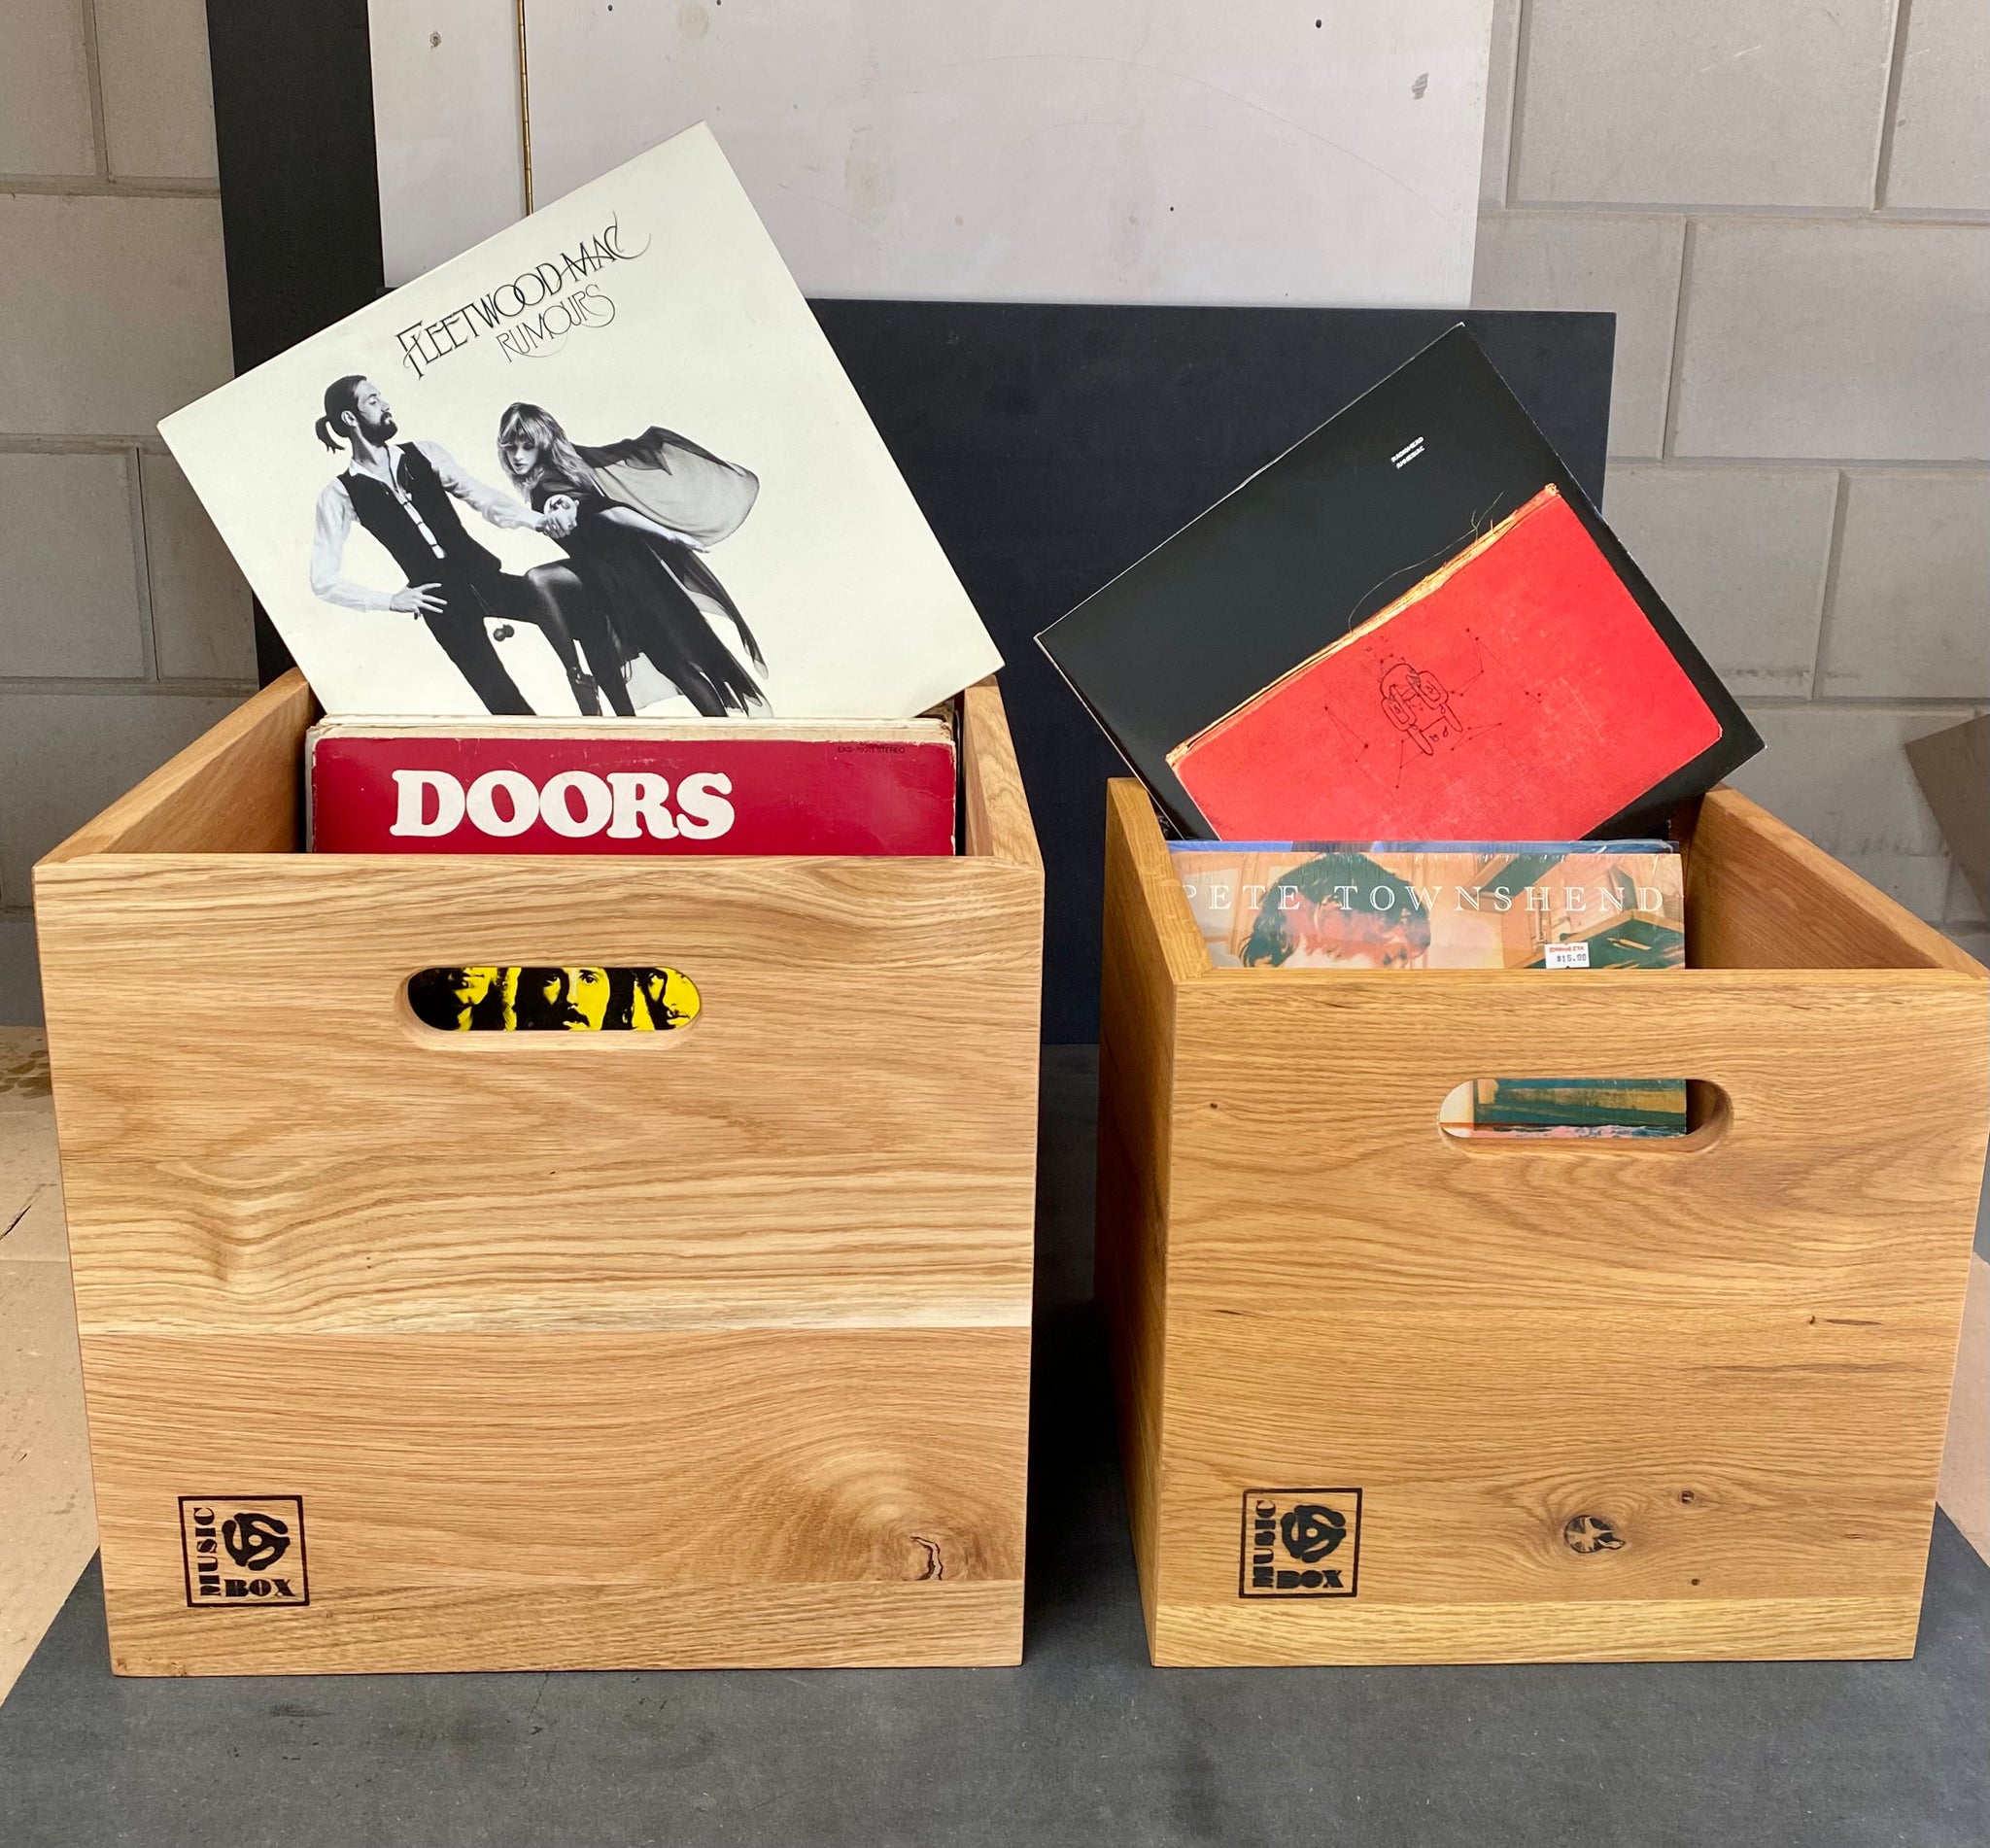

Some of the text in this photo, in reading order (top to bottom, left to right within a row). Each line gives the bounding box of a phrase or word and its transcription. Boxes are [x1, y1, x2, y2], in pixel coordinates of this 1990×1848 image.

[395, 211, 652, 380] FLEETWOOD MAC
[496, 284, 616, 363] RUMOURS
[876, 745, 907, 754] STEREO
[390, 769, 736, 840] DOORS
[1334, 884, 1664, 912] TOWNSHEND
[1557, 953, 1587, 963] $15.99
[192, 1507, 222, 1596] MUSIC
[1252, 1499, 1277, 1589] MUSIC
[223, 1578, 296, 1597] BOX
